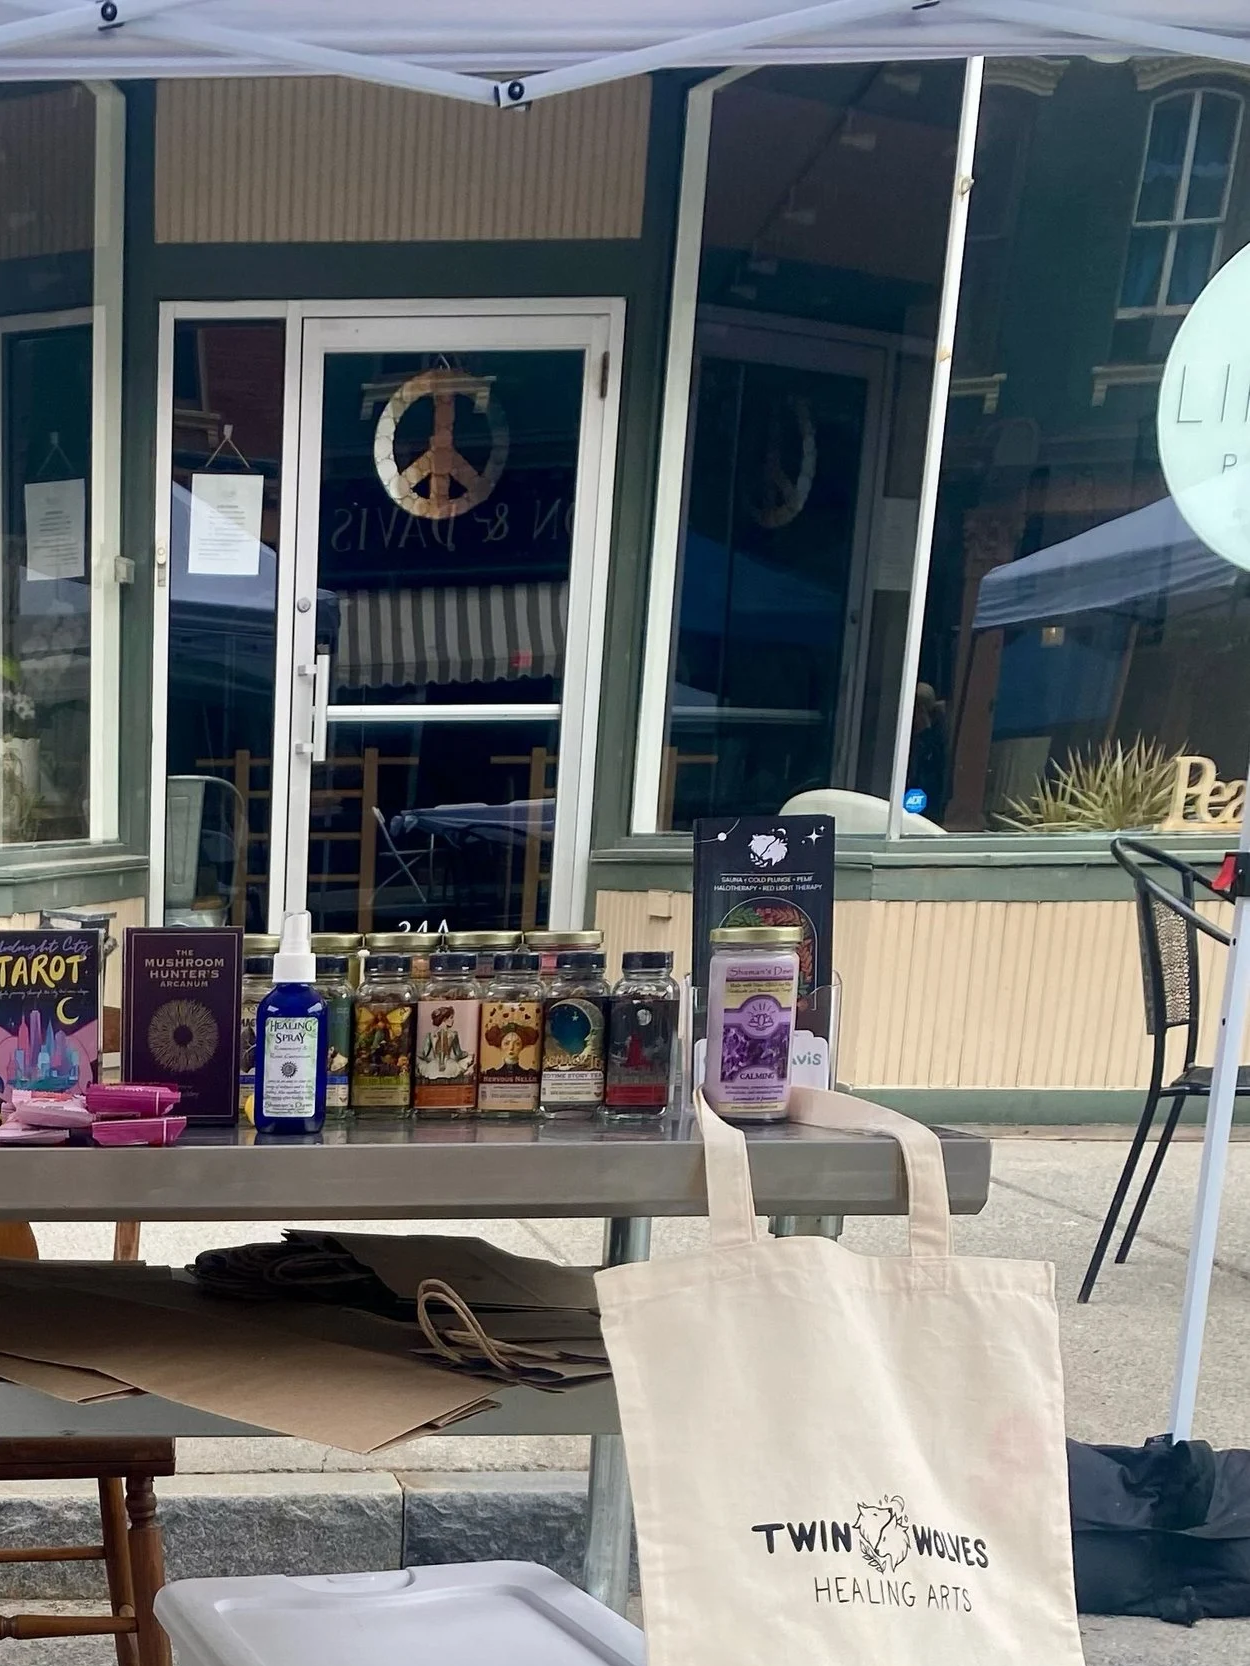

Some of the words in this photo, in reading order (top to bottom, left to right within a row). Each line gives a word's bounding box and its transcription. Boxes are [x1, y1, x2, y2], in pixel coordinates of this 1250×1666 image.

[1176, 362, 1250, 423] LI
[1164, 755, 1246, 825] Pea
[61, 935, 94, 957] City
[175, 949, 194, 957] THE
[144, 958, 225, 968] MUSHROOM
[149, 969, 220, 979] HUNTER'S
[159, 980, 209, 988] ARCANUM
[270, 1020, 313, 1032] HEALING
[275, 1032, 307, 1044] SPRAY
[739, 1072, 775, 1080] CALMING
[751, 1519, 852, 1554] TWIN
[912, 1523, 989, 1568] WOLVES
[814, 1576, 916, 1607] HEALING
[927, 1584, 973, 1613] ARTS
